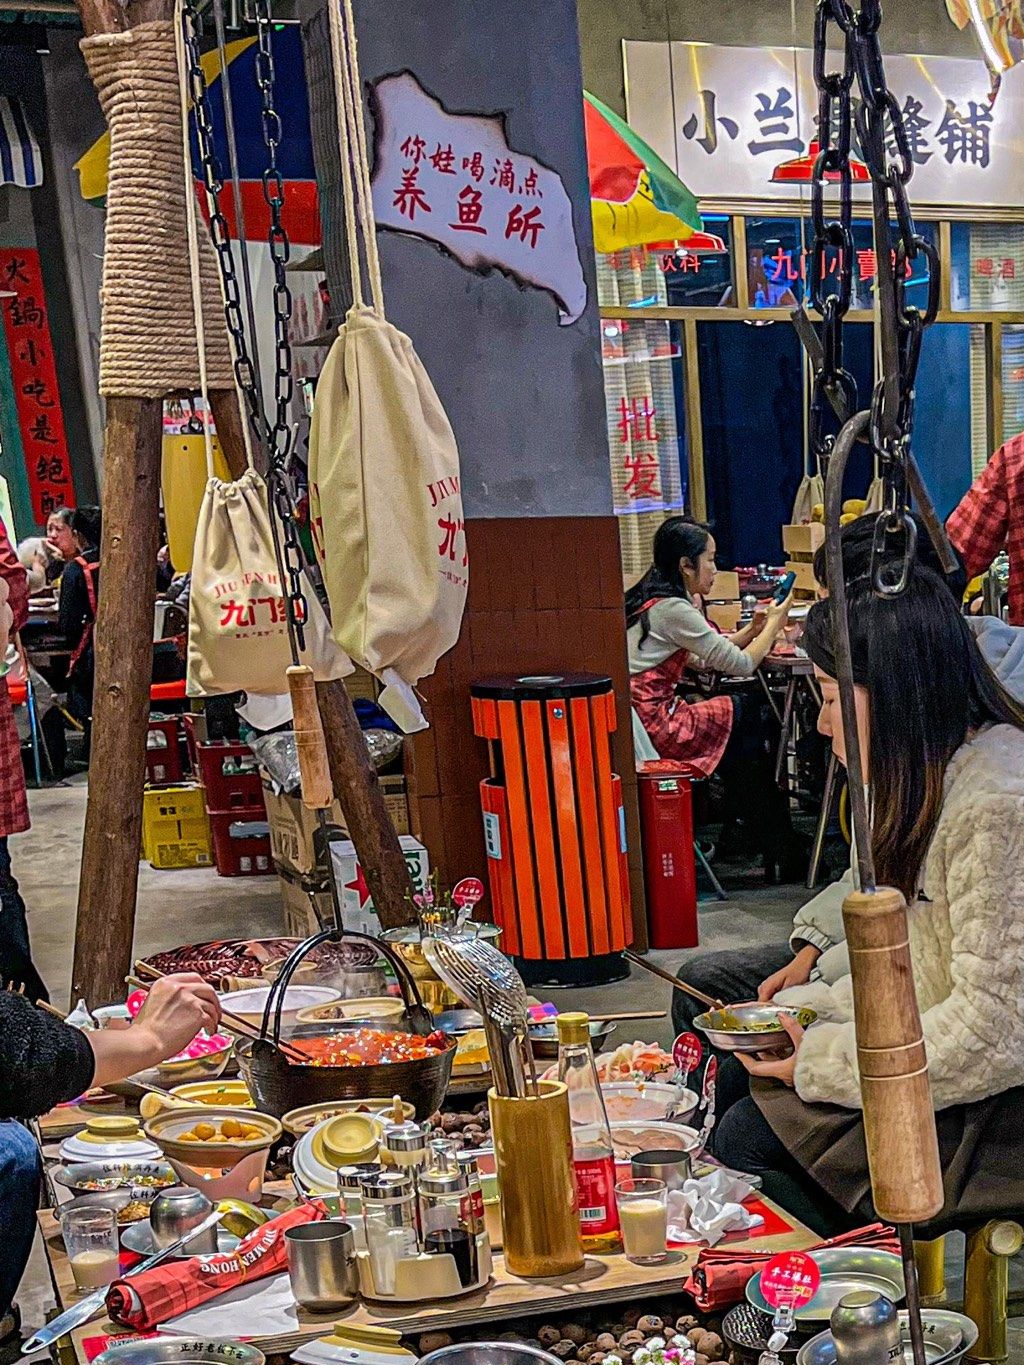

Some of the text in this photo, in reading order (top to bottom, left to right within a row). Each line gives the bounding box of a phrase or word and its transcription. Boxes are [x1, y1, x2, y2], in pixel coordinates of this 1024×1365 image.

[392, 166, 546, 249] 养鱼所
[399, 133, 543, 199] 你娃喝滴点
[616, 395, 660, 499] 批发
